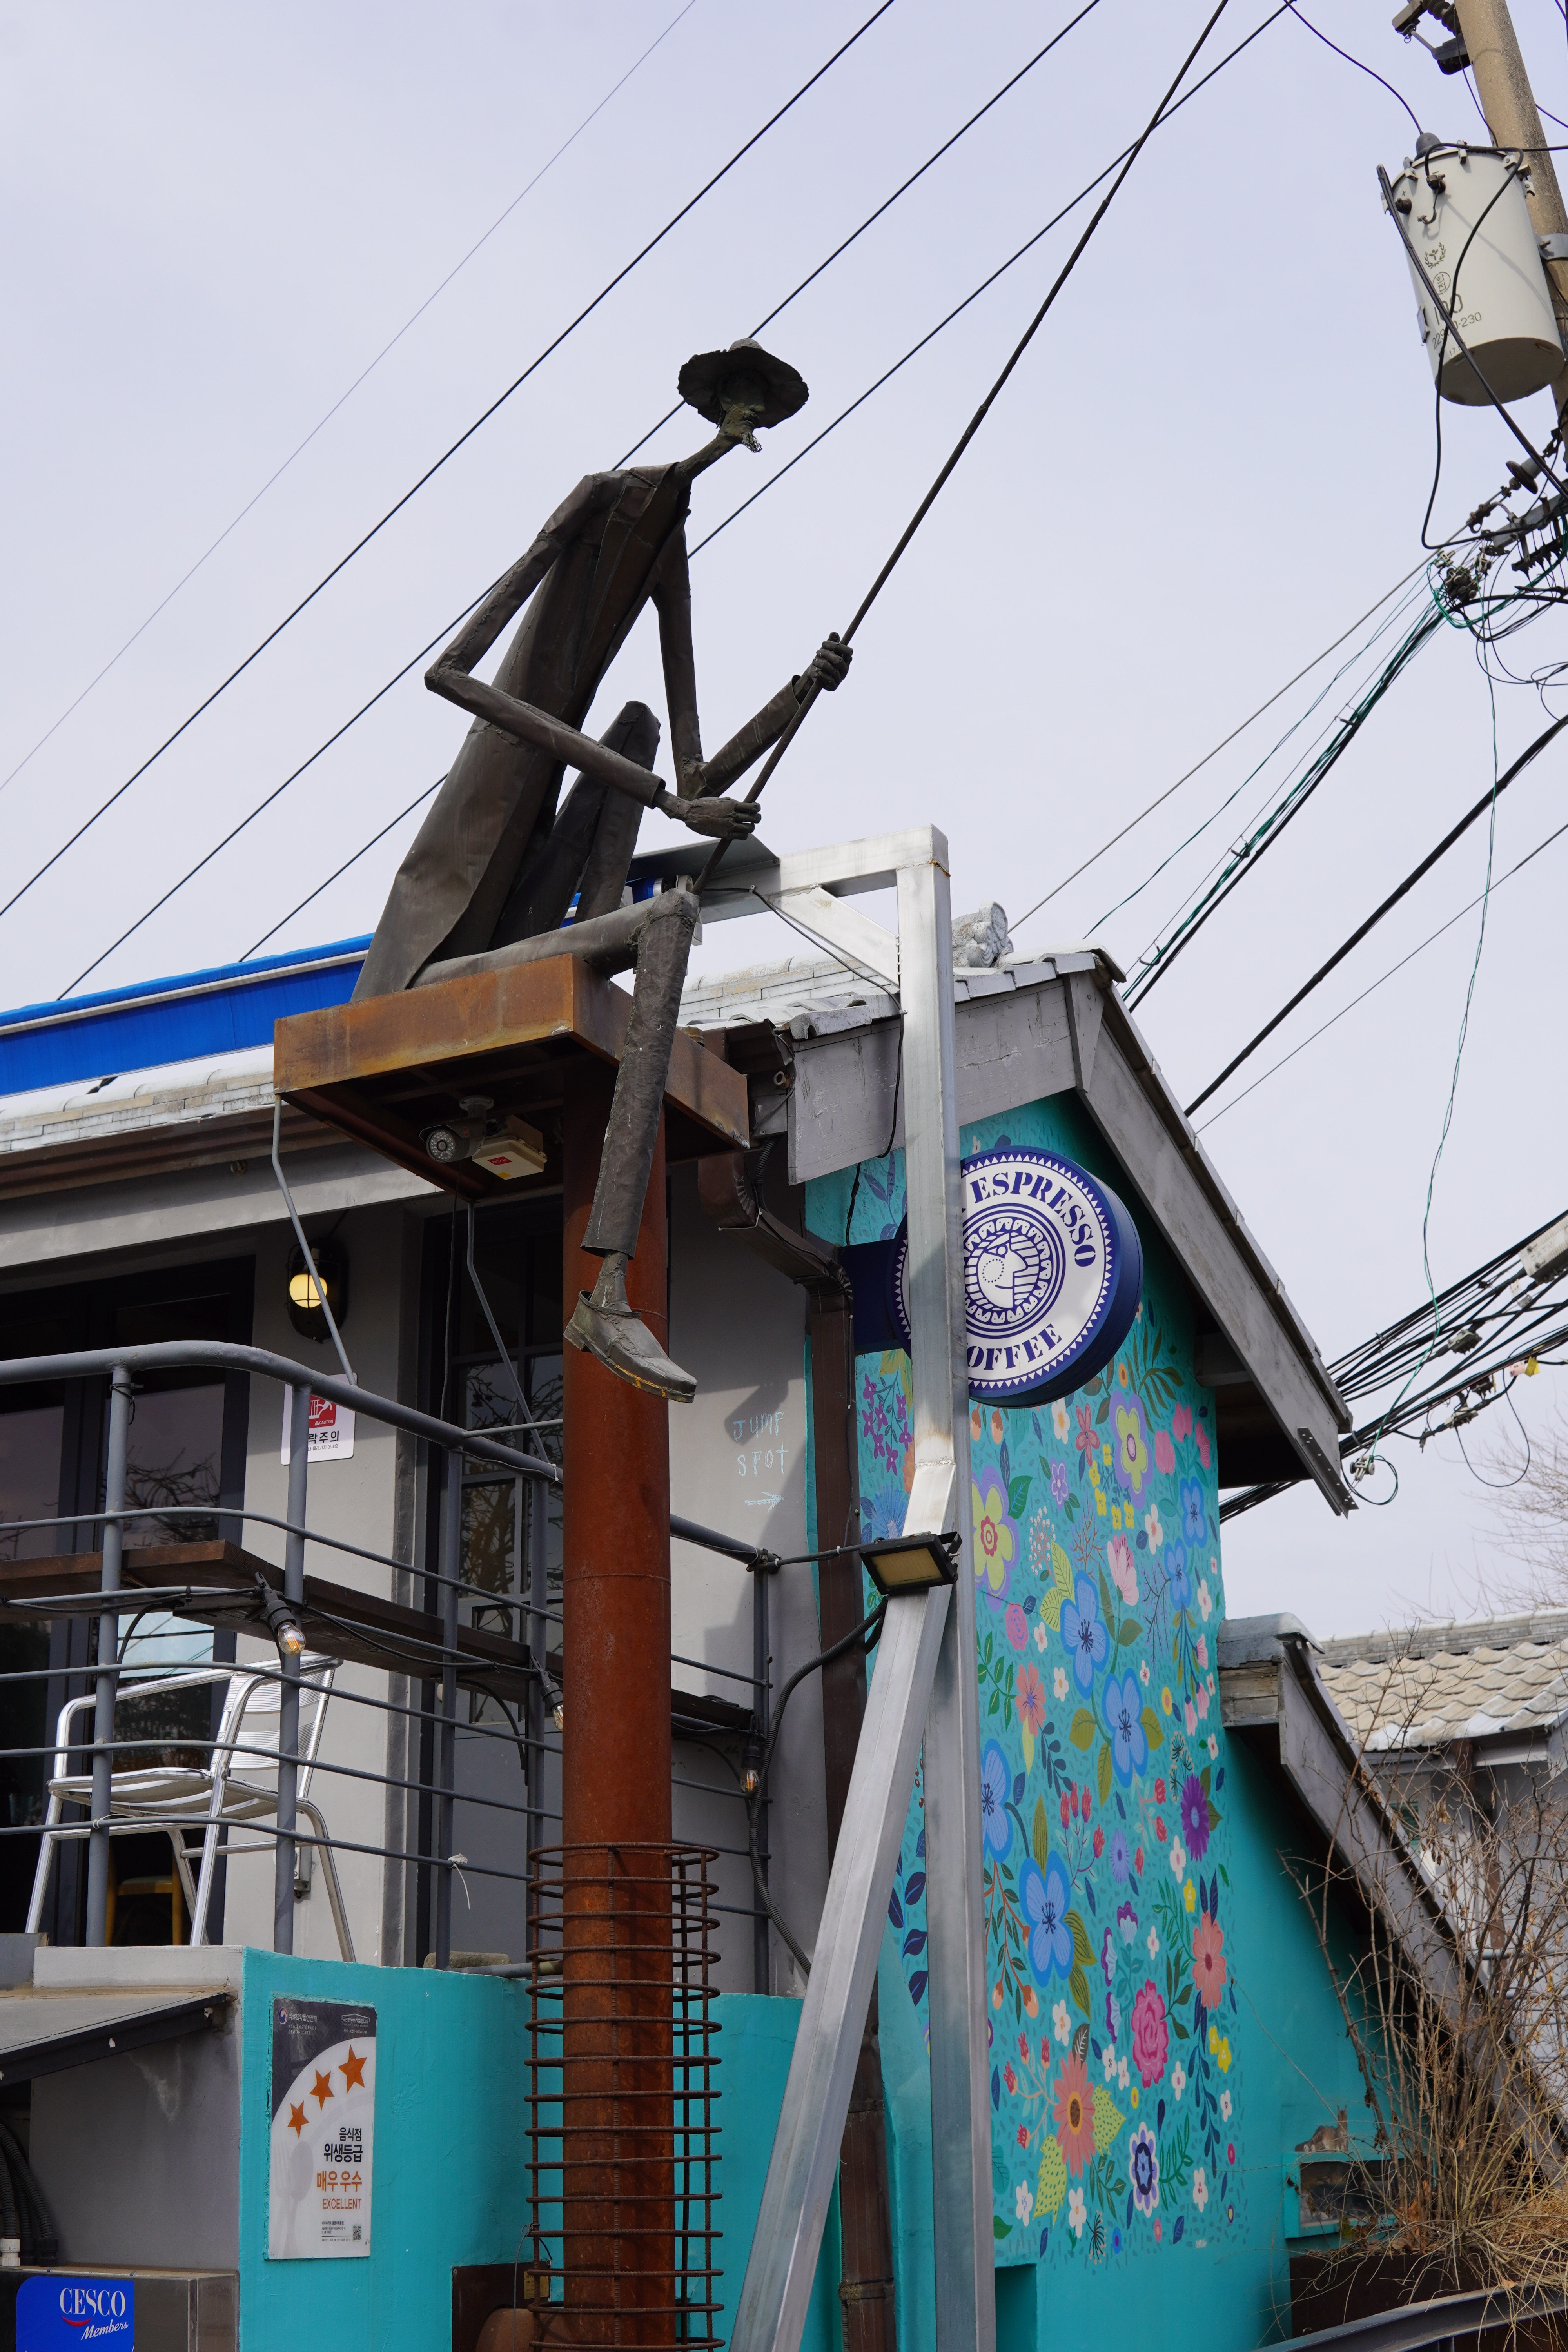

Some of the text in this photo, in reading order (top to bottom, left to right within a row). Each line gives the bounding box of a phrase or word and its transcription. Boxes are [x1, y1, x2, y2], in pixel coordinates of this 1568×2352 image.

[969, 1171, 1096, 1267] ESPRESSO
[967, 1323, 1062, 1370] OFFEE
[309, 1430, 339, 1444] 락주의
[339, 2127, 362, 2141] 음식점
[324, 2143, 363, 2163] 위생등급
[317, 2171, 362, 2192] 매우 우수
[323, 2198, 362, 2209] EXCELLENT
[60, 2288, 126, 2317] CESCO
[80, 2319, 129, 2341] Members
